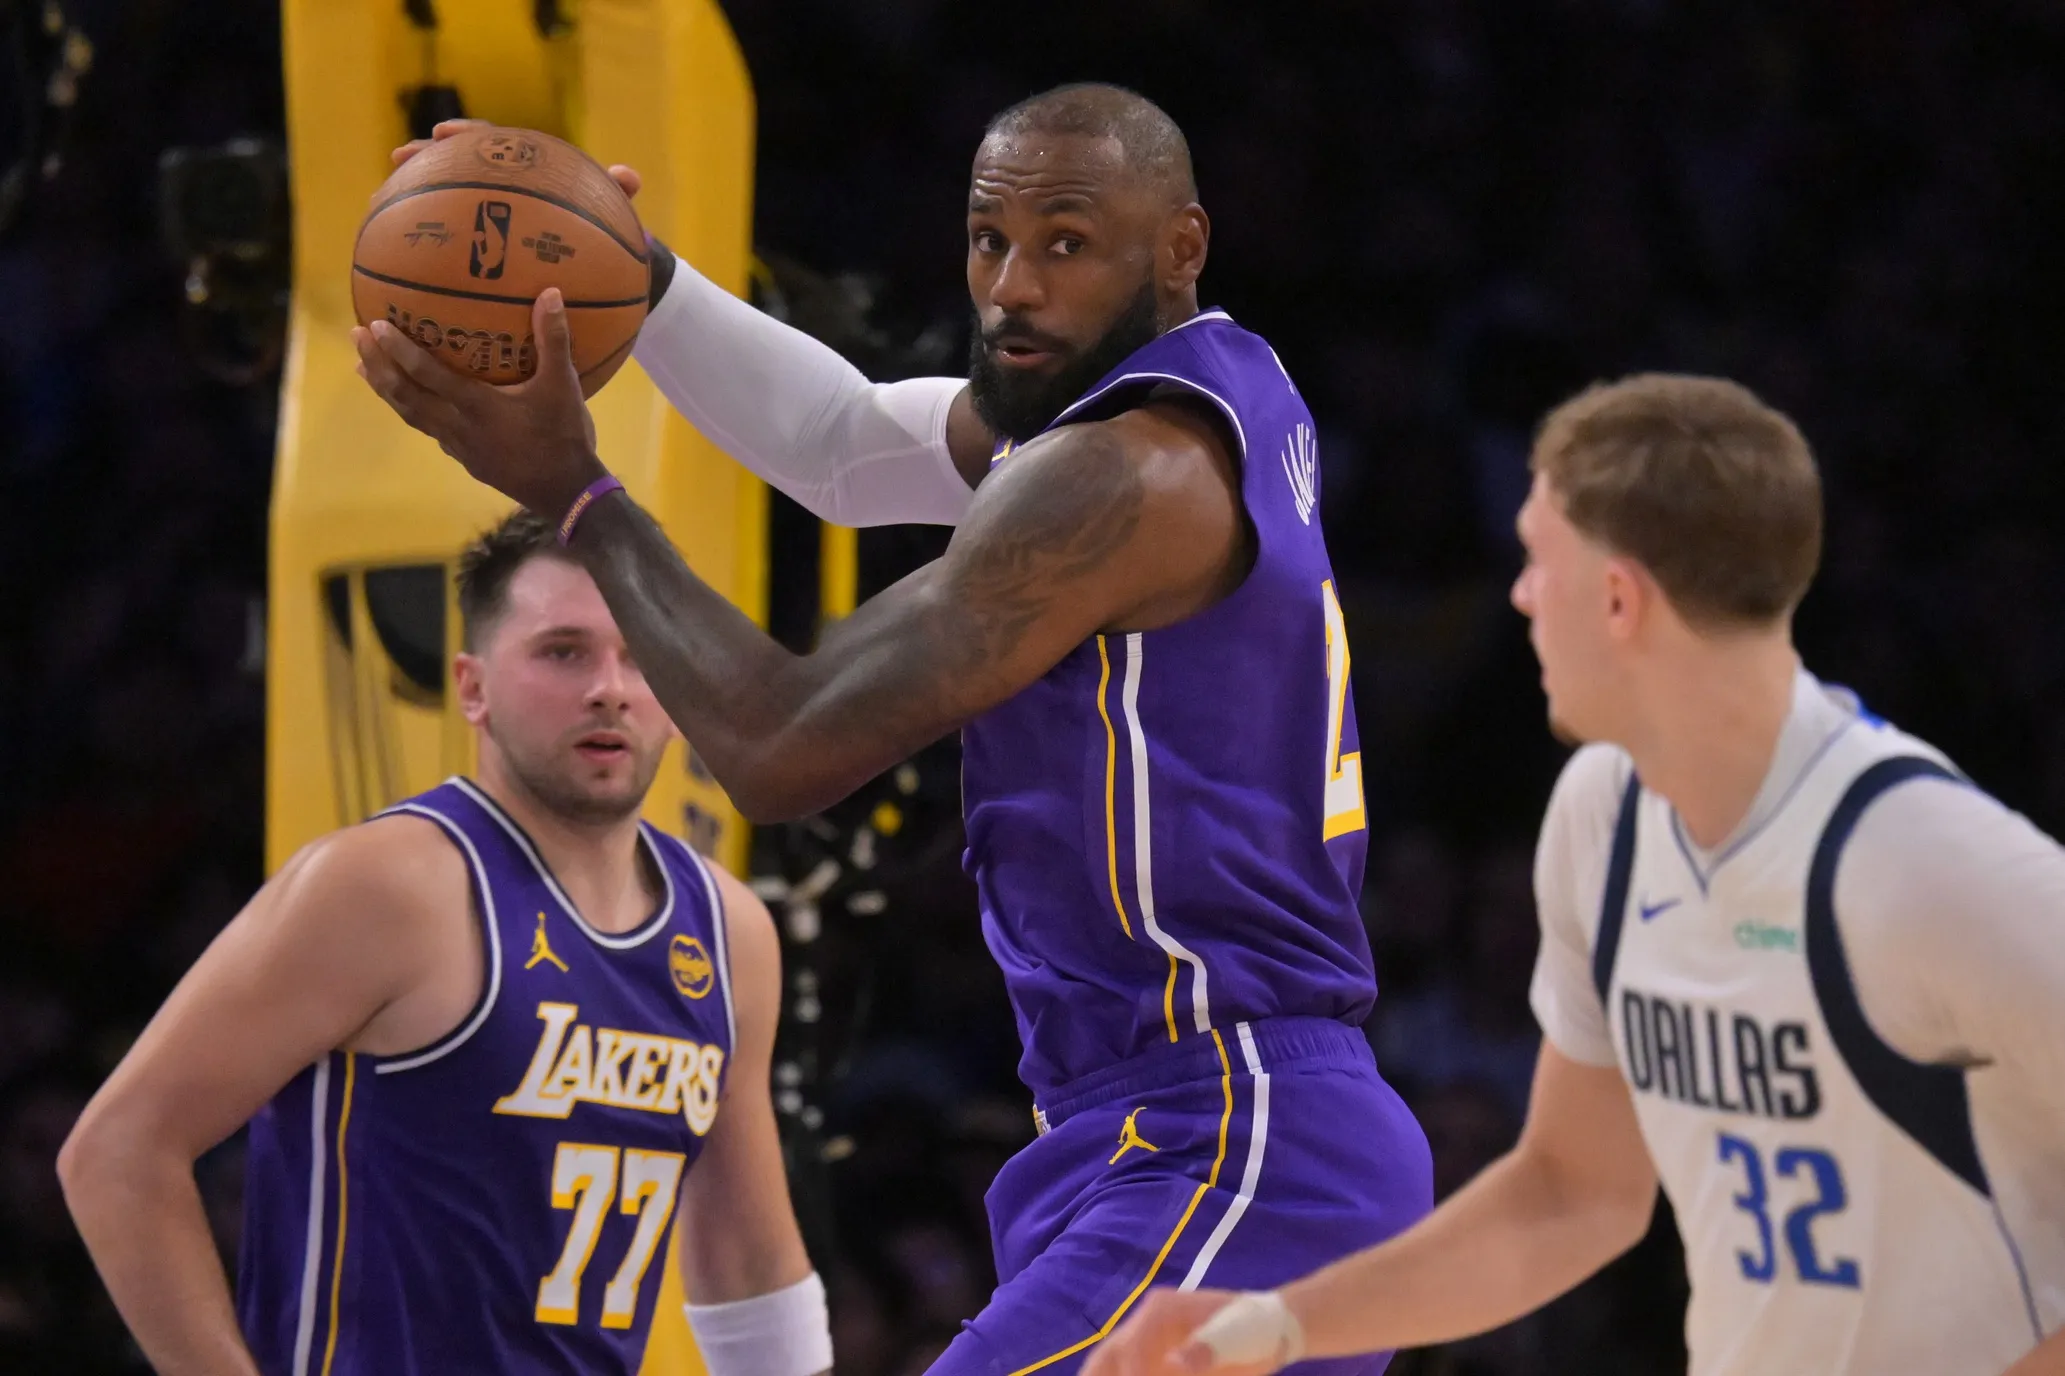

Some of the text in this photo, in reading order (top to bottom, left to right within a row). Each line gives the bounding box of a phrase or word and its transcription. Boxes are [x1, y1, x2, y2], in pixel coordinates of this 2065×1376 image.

[562, 491, 593, 534] PROMISE
[492, 1001, 725, 1136] LAKERS
[1622, 988, 1821, 1122] DALLAS
[535, 1141, 687, 1330] 77
[1716, 1130, 1863, 1291] 32
